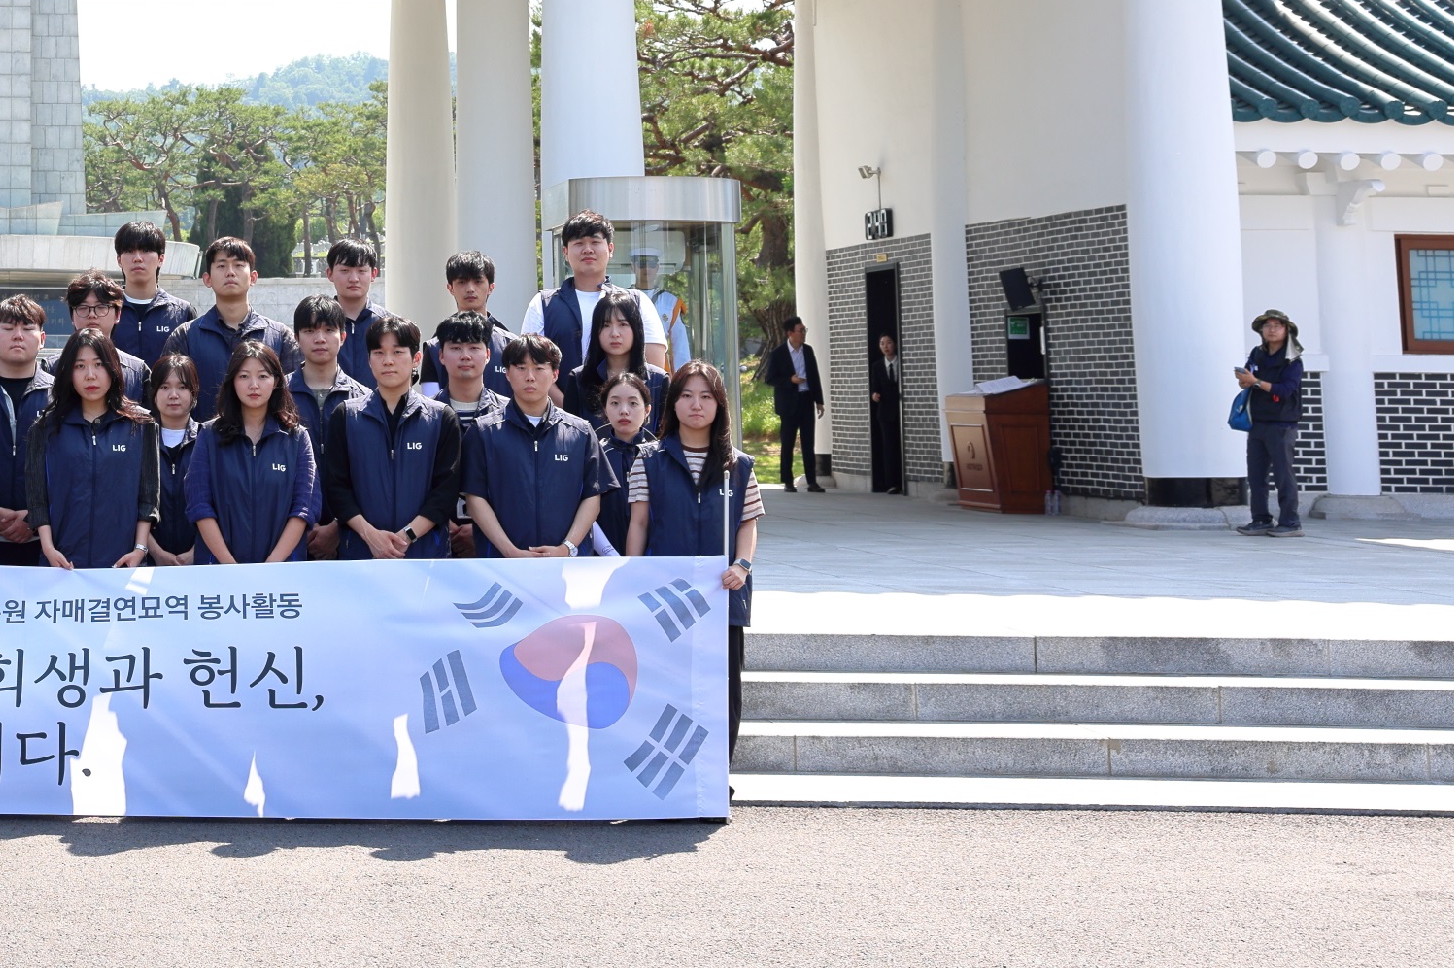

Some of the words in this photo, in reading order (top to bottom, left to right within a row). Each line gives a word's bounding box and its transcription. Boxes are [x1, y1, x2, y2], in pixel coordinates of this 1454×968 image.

[156, 325, 170, 333] LIG
[112, 444, 126, 453] LIG
[406, 442, 423, 450] LIG
[554, 454, 569, 462] LIG
[271, 462, 287, 473] LIG
[719, 488, 734, 497] LG
[33, 594, 189, 624] 자매결연묘역
[197, 592, 303, 621] 봉사활동
[183, 645, 326, 713] 헌신,
